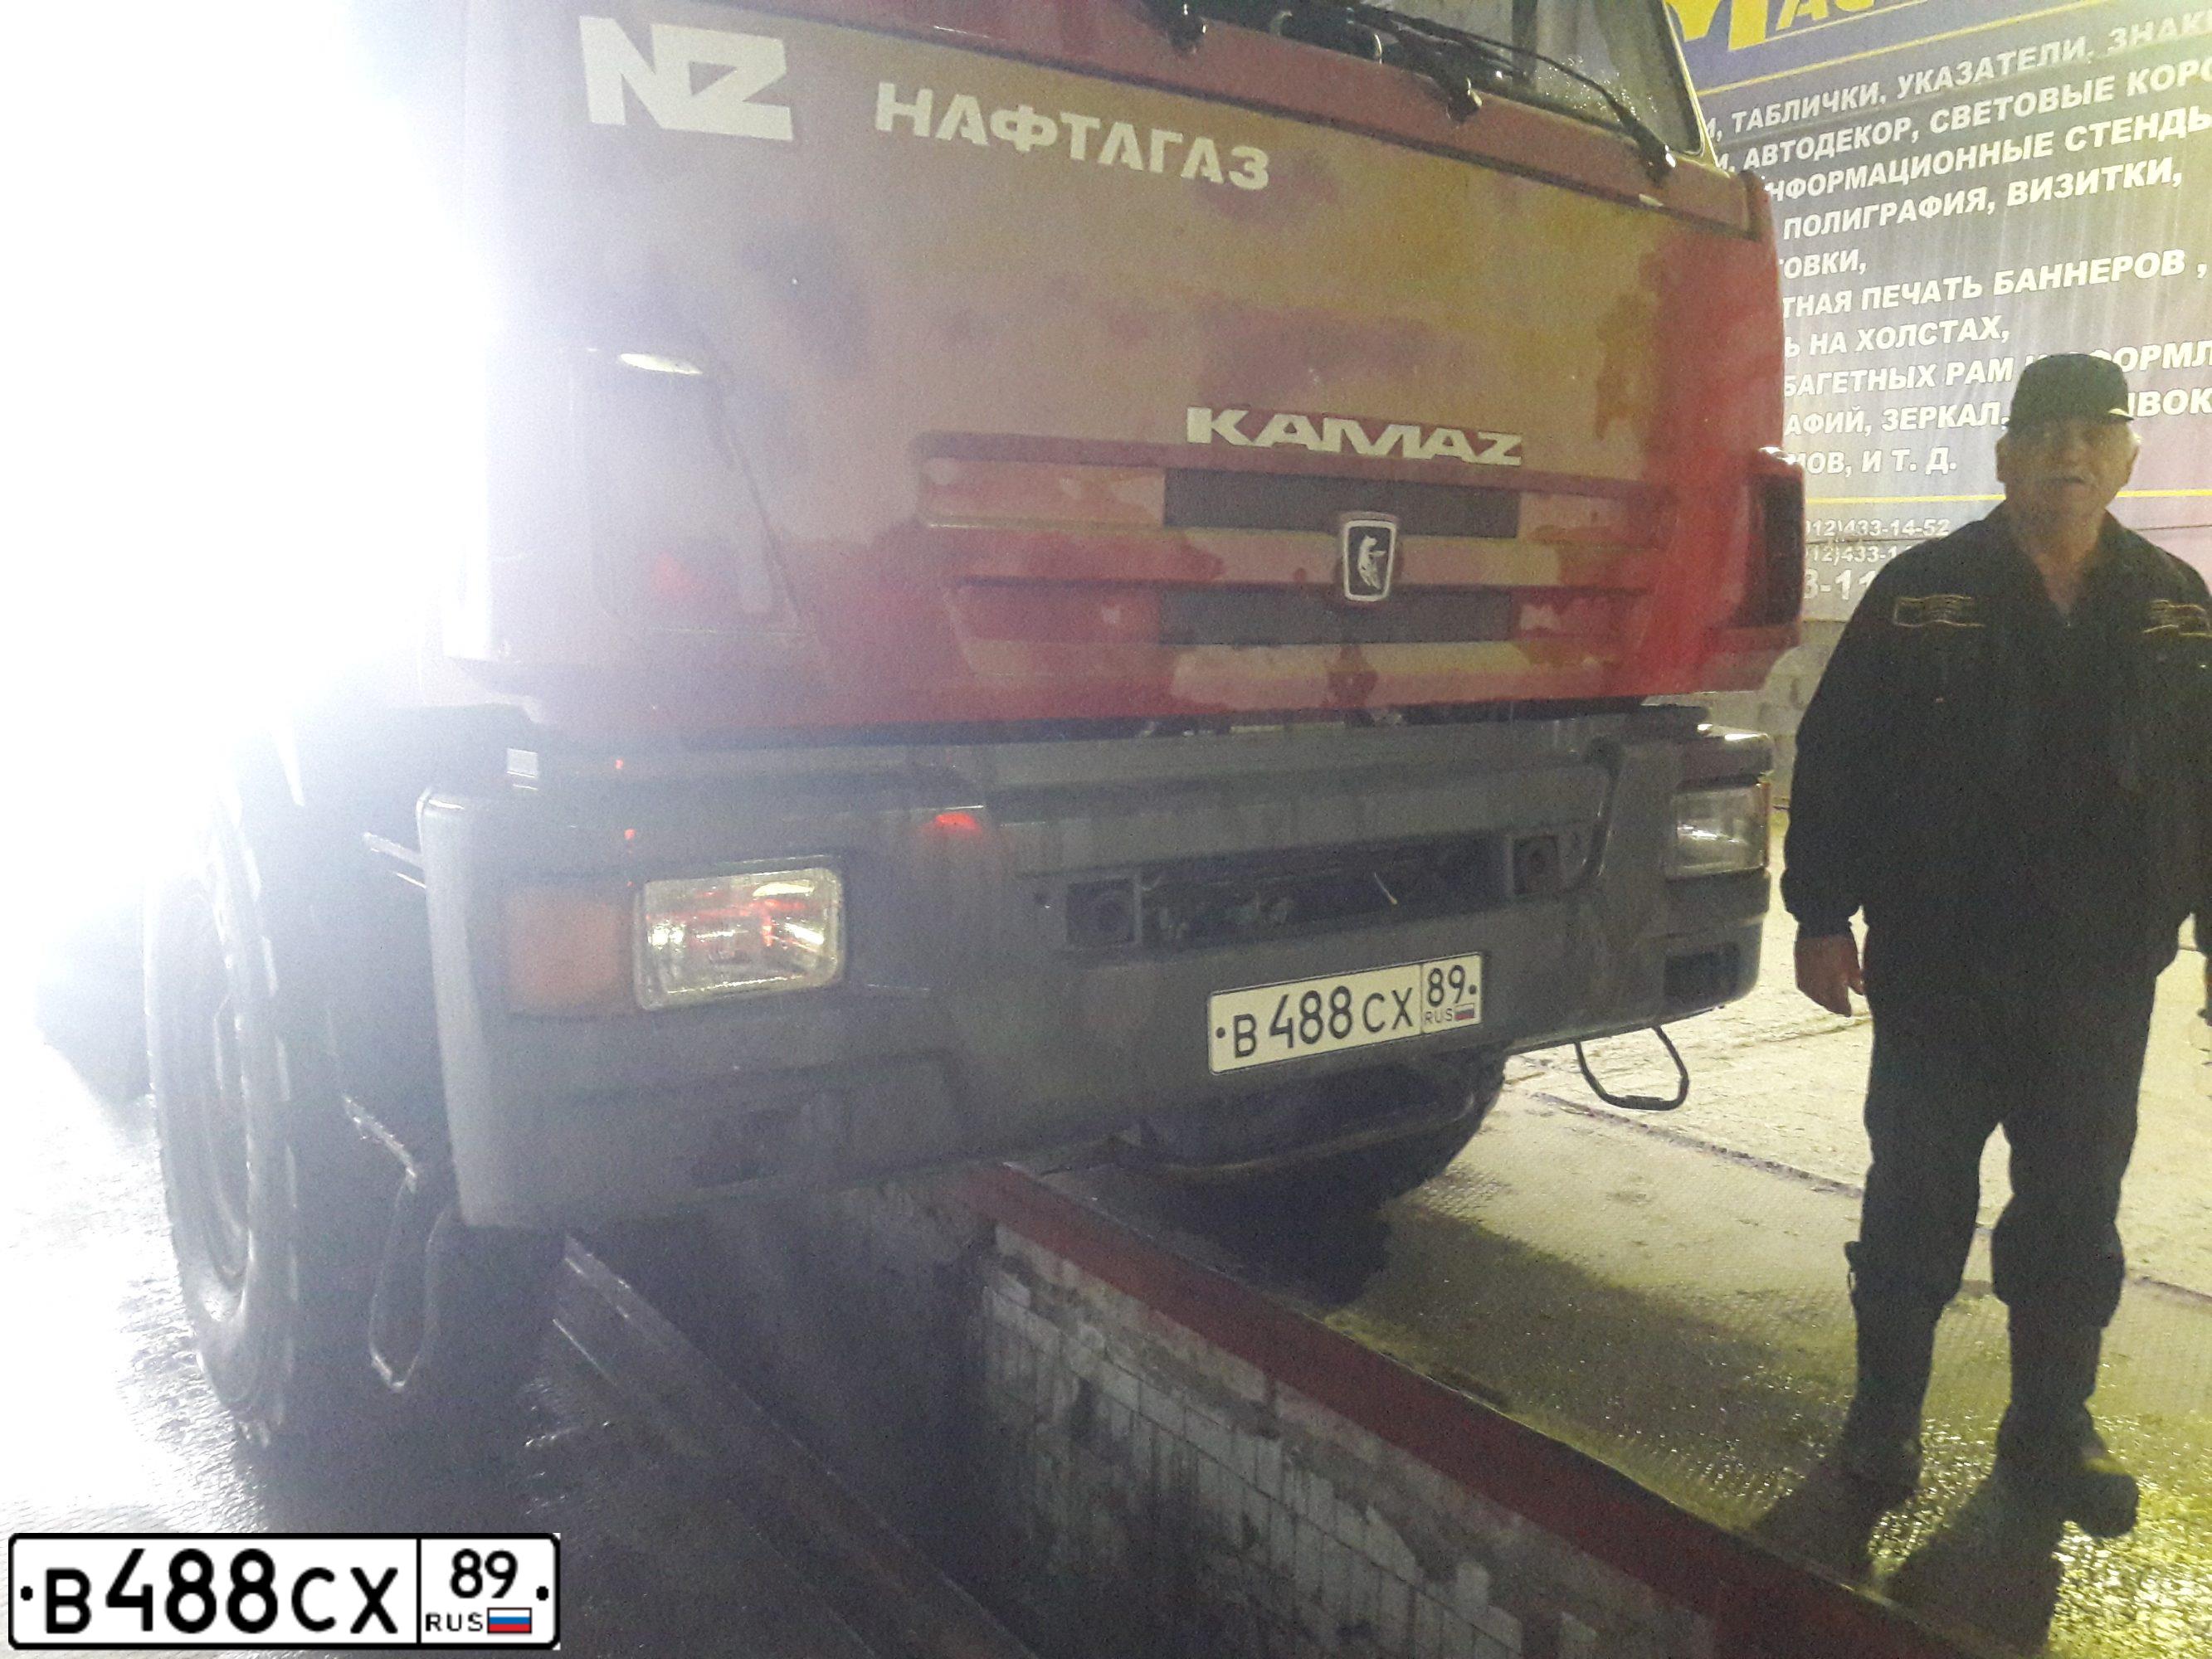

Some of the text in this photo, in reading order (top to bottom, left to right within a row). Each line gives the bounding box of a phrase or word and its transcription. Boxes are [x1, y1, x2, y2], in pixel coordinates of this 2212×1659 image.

[578, 15, 793, 141] NZ
[1732, 81, 1887, 134] ТАБЛИЧКИ,
[2107, 8, 2212, 54] ЗНАК
[875, 81, 1270, 192] НАФТАГАЗ
[1743, 117, 1919, 170] АВТОДЕКОР,
[1929, 75, 2116, 134] СВЕТОВЫЕ
[1784, 157, 2183, 240] ПОЛИГРАФИЯ, ВИЗИТКИ,
[1778, 249, 1867, 280] ОВКИ,
[1861, 275, 1983, 311] ПЕЧАТЬ
[1993, 249, 2185, 295] БАННЕРОВ
[1810, 331, 1848, 356] НА
[1855, 314, 2010, 353] ХОЛСТАХ,
[1784, 363, 1938, 397] БАГЕТНЫХ
[1945, 357, 2015, 386] РАМ
[1186, 406, 1523, 466] KAMAZ
[1861, 449, 1883, 473] И
[1427, 964, 1466, 1007] 89
[1425, 1008, 1454, 1025] RUS
